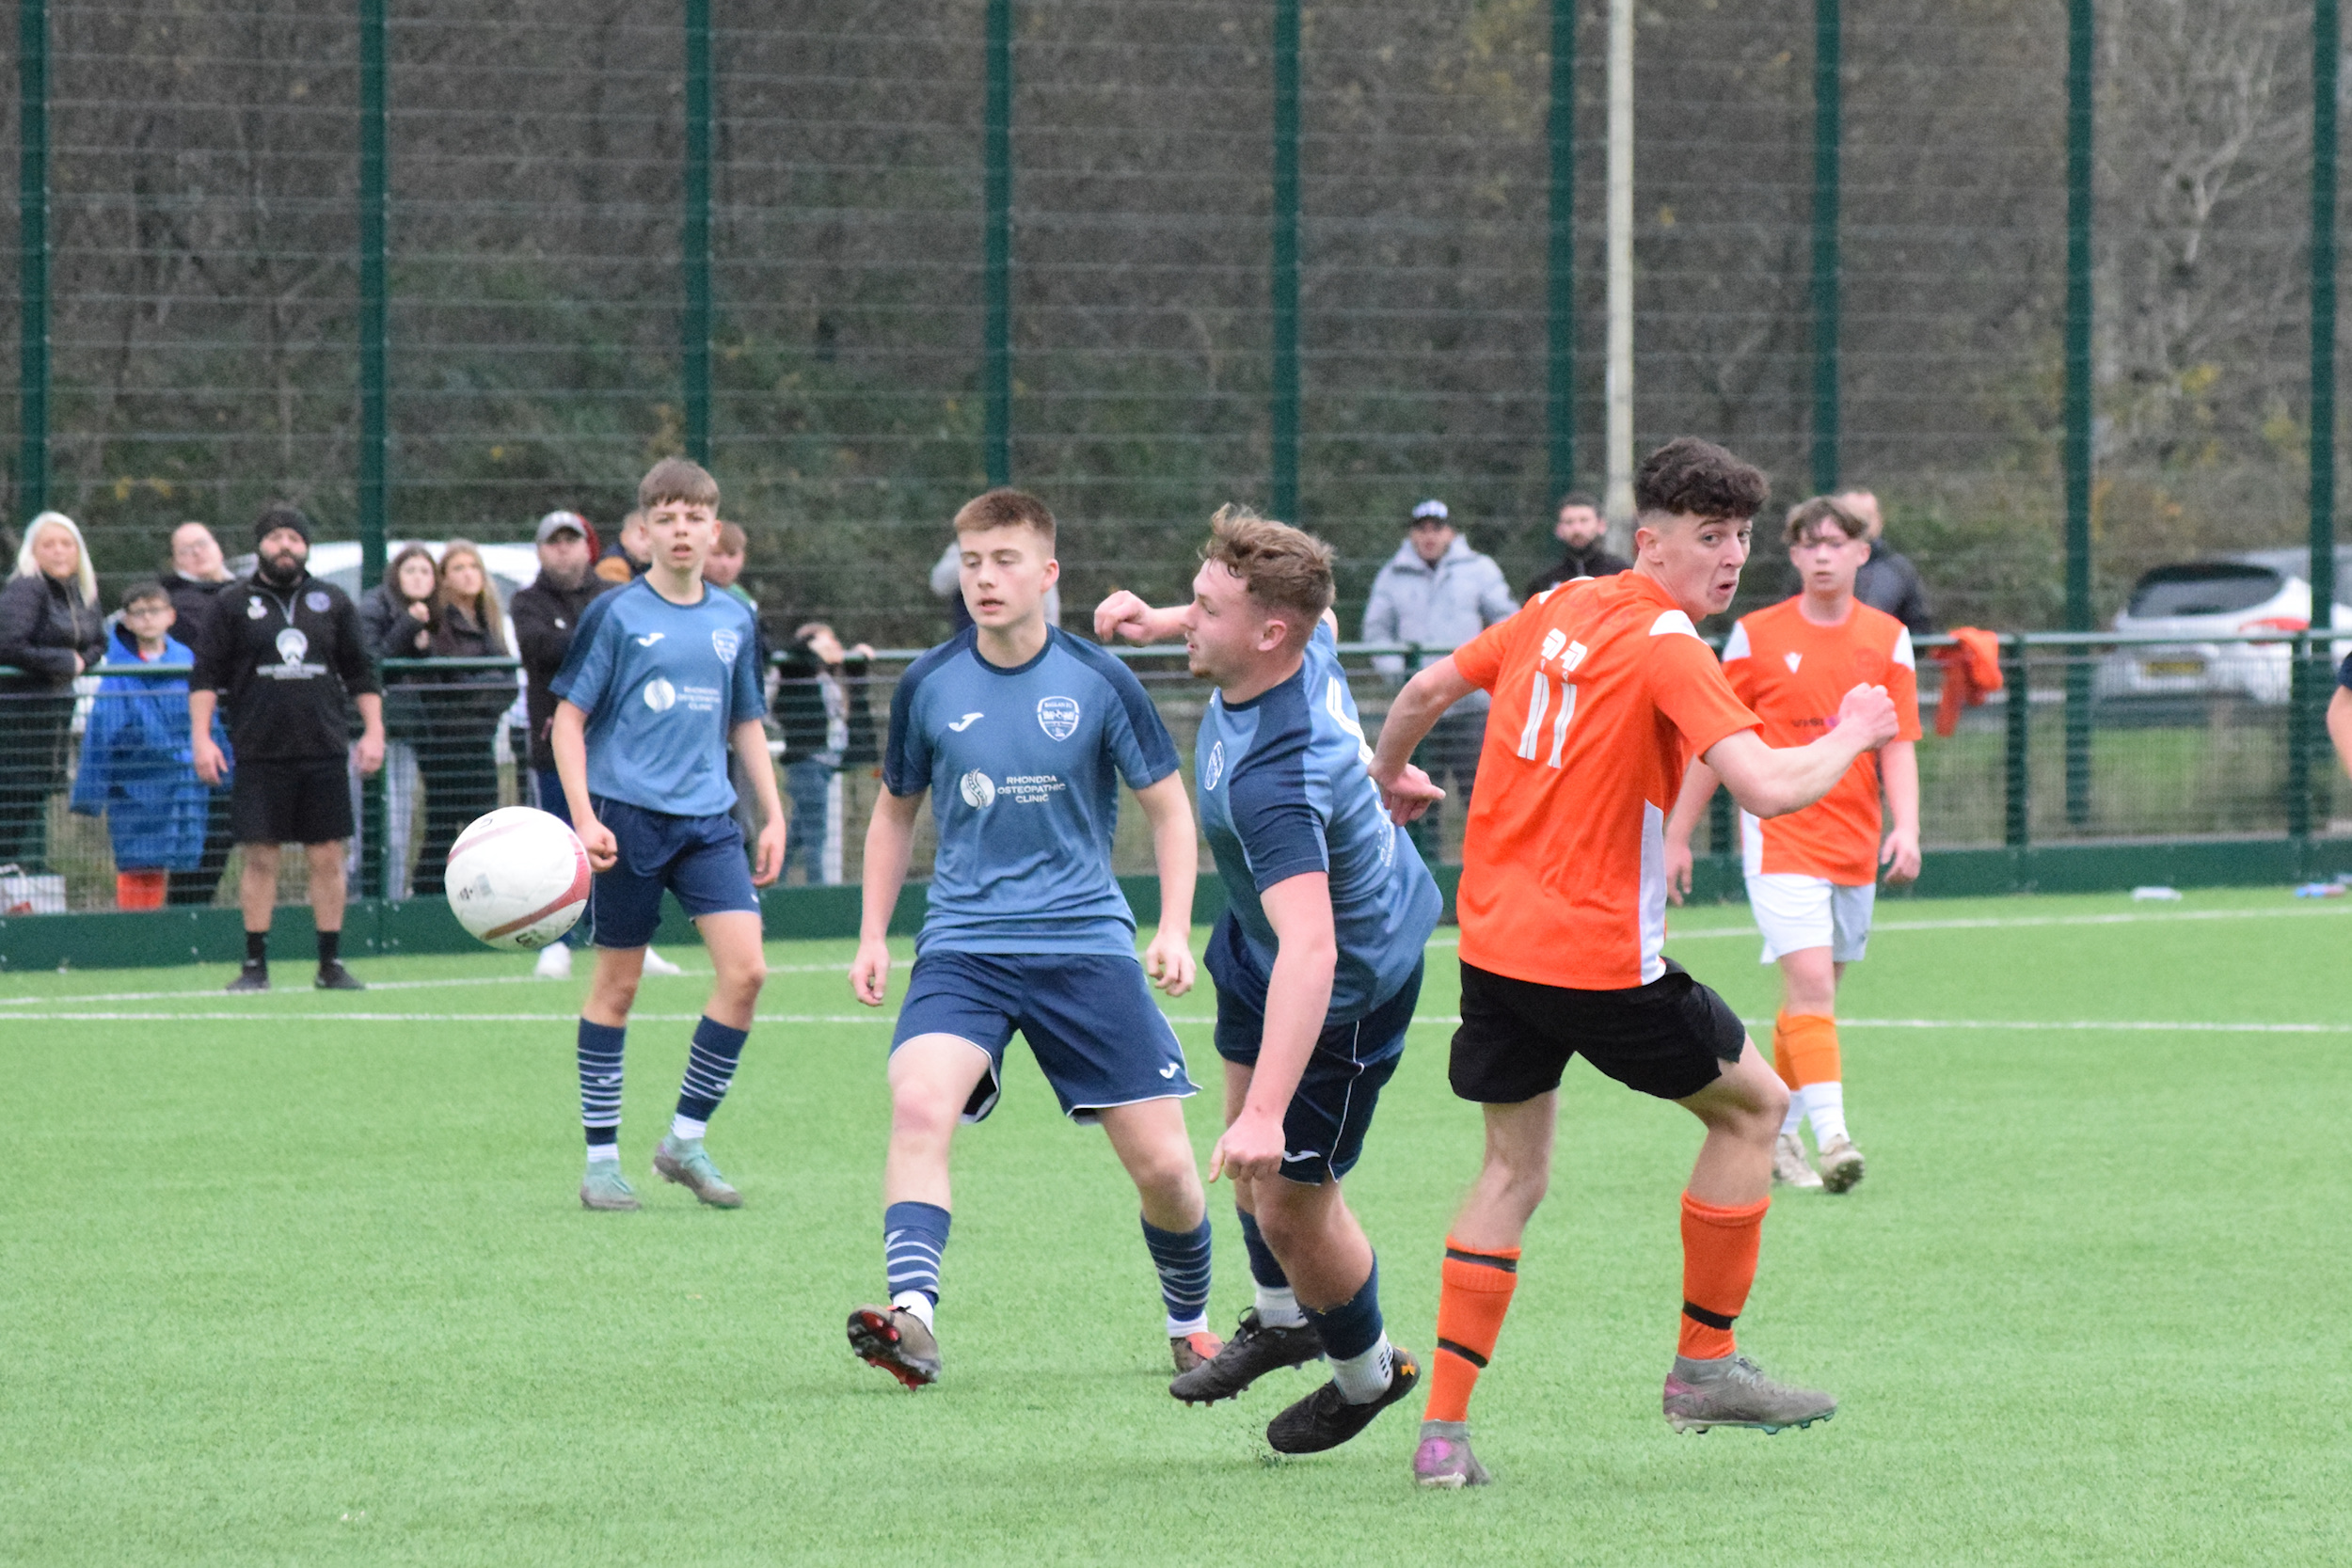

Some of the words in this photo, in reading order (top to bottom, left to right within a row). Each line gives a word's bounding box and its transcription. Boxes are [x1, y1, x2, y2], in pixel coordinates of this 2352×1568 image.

[1518, 627, 1588, 768] 11
[1006, 775, 1057, 784] RHONDDA
[997, 783, 1066, 794] OSTEOPATHIC
[1015, 794, 1049, 803] CLINIC
